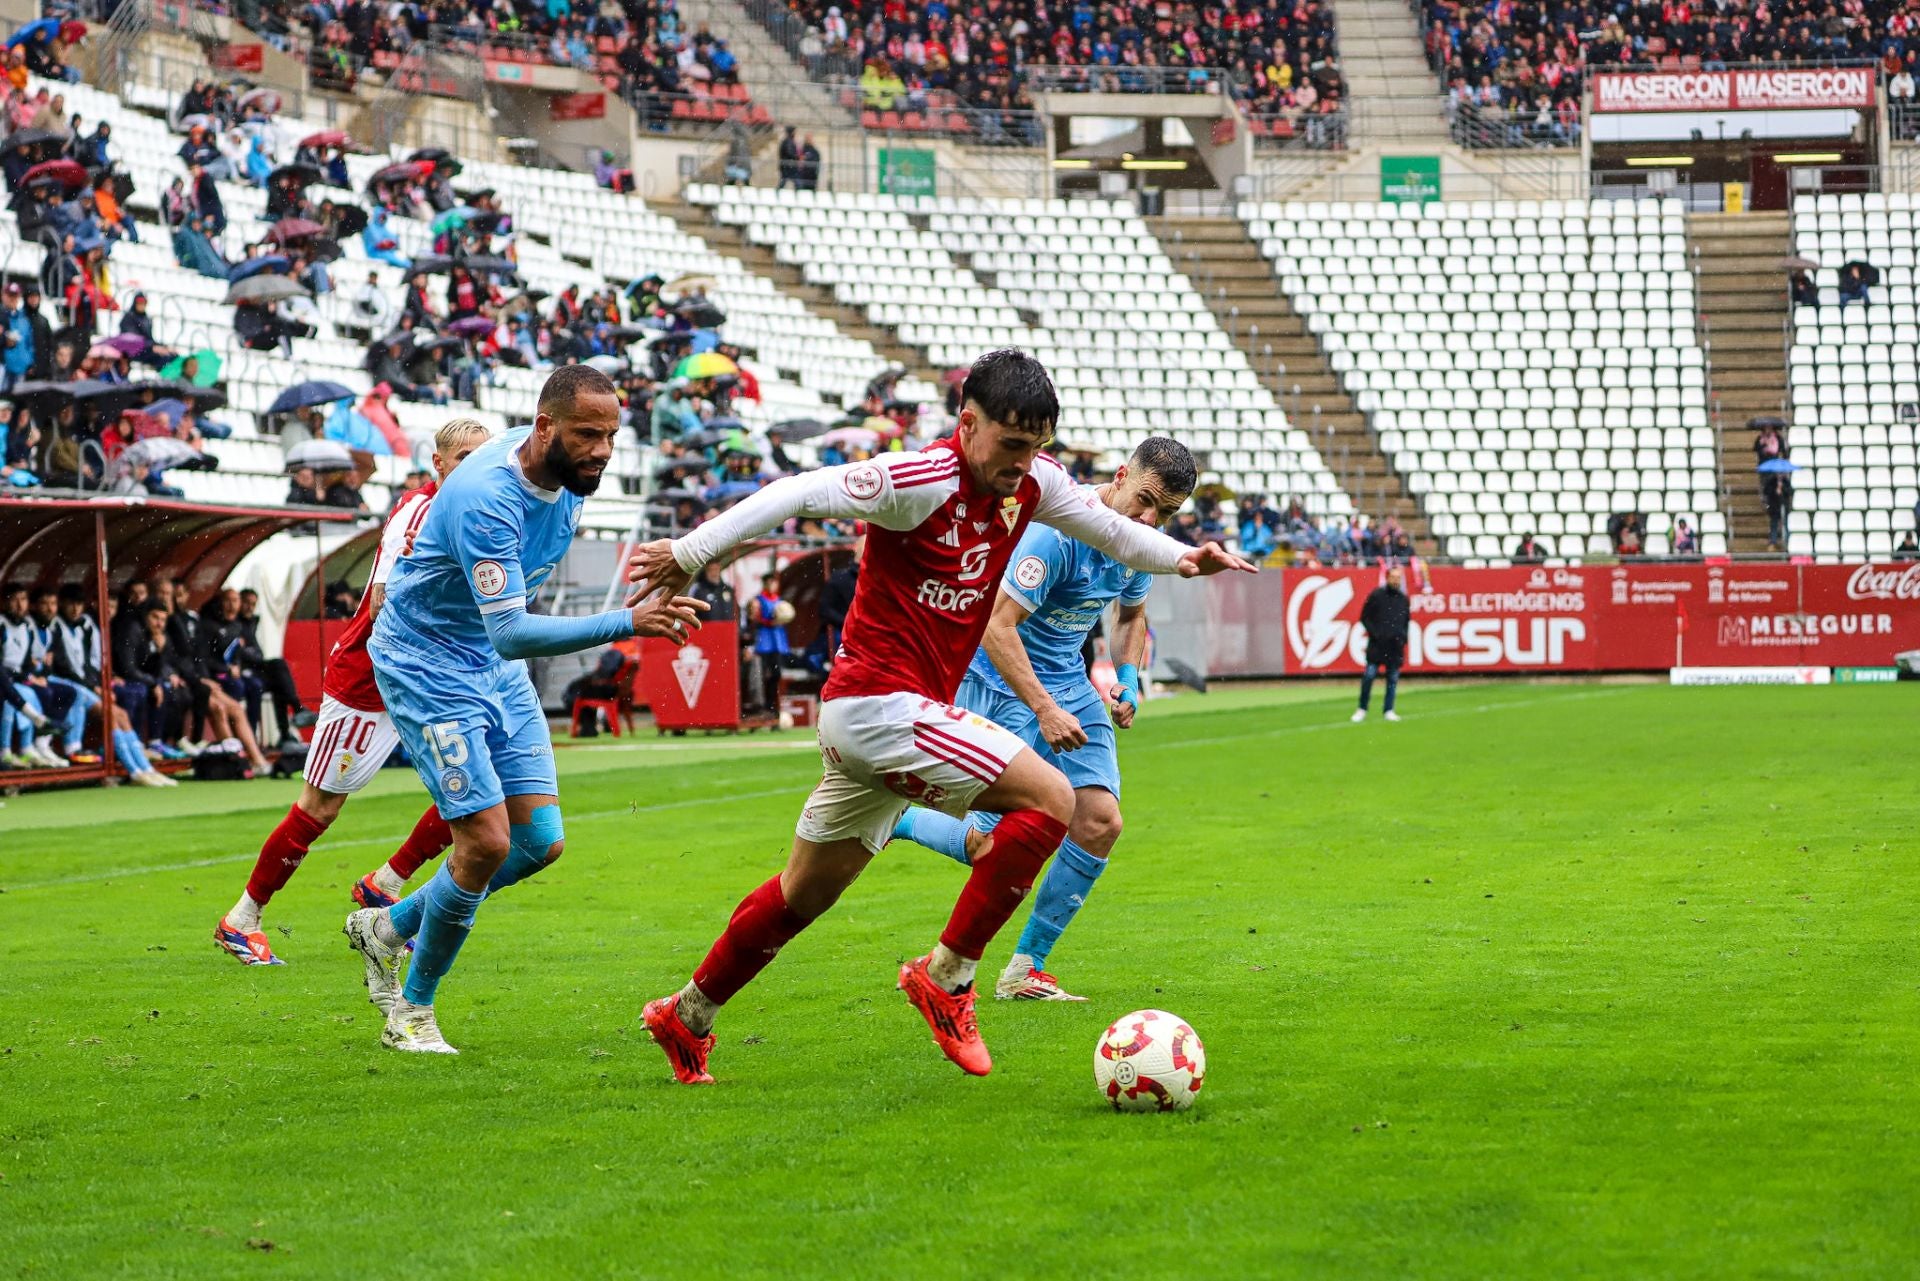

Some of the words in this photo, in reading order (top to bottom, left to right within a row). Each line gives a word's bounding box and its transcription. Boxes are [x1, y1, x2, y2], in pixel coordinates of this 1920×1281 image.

[1601, 75, 1729, 100] MASERCON
[1737, 71, 1866, 97] MASERCON
[1449, 590, 1585, 612] ELECTRÓGENOS
[1751, 614, 1892, 634] MESEGUER
[343, 715, 377, 755] 10
[422, 720, 469, 770] 15
